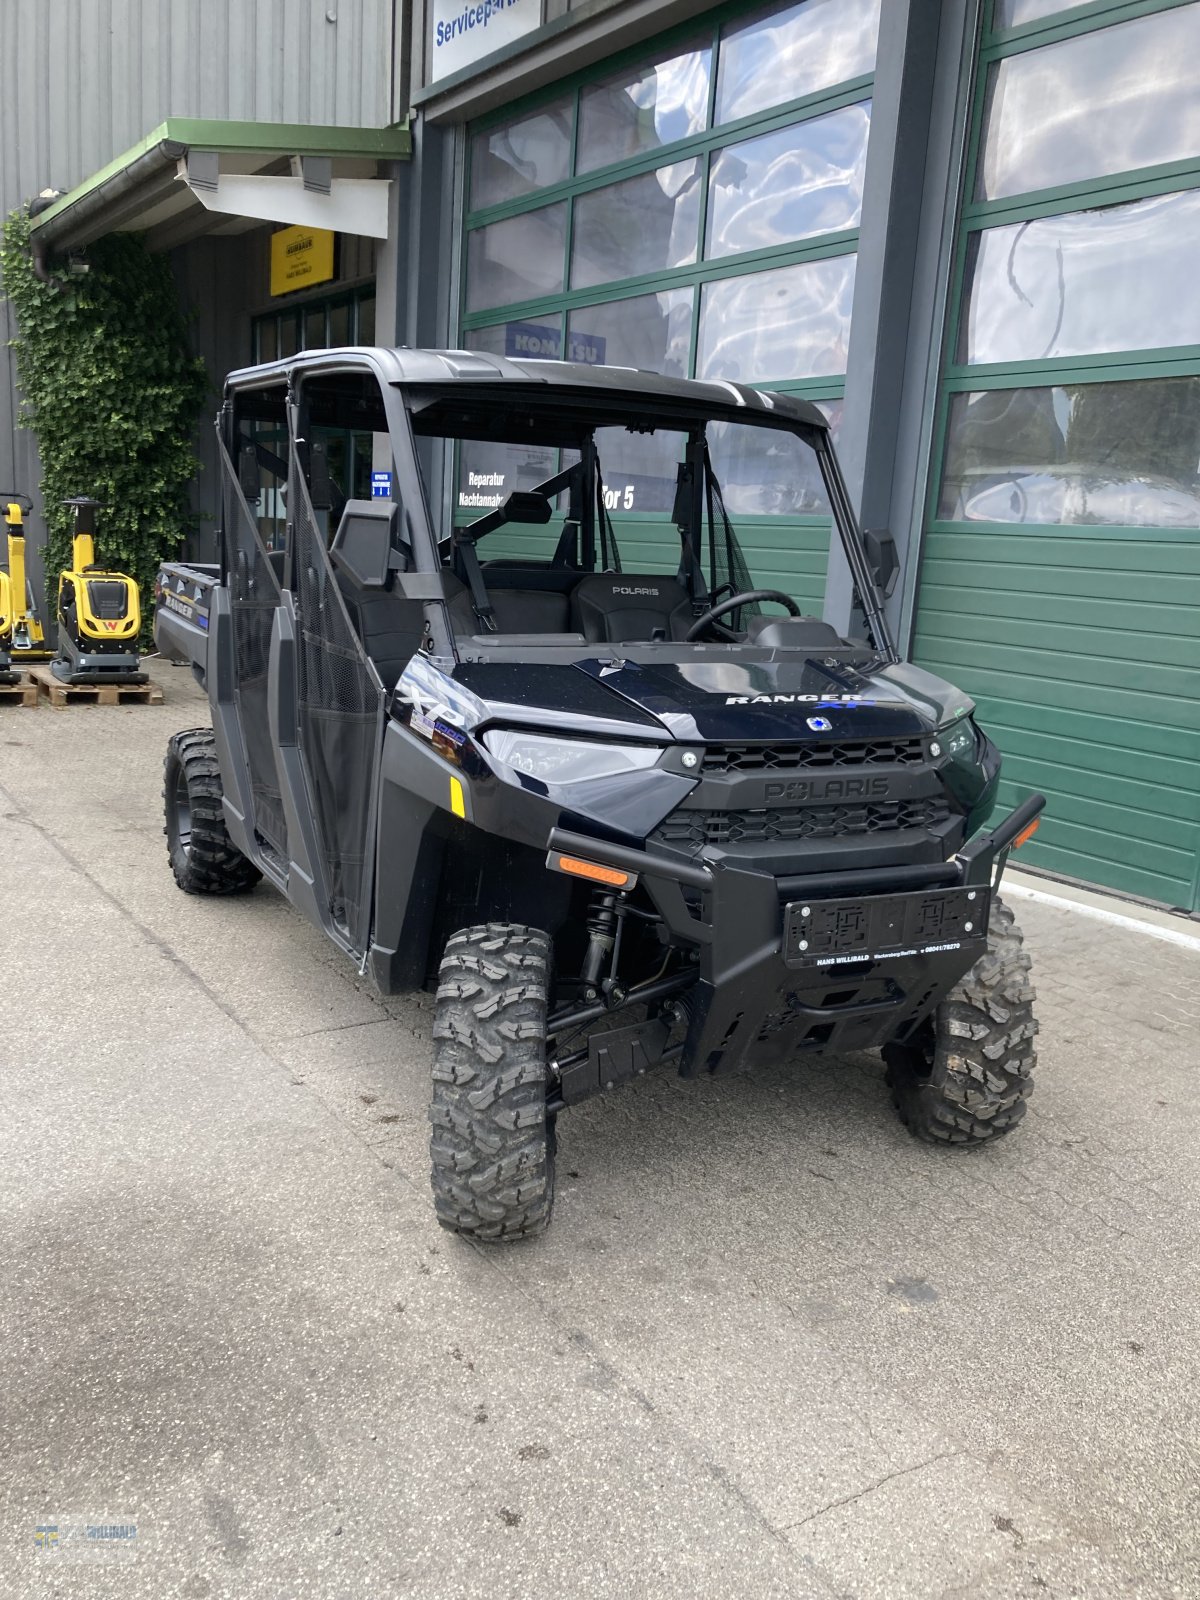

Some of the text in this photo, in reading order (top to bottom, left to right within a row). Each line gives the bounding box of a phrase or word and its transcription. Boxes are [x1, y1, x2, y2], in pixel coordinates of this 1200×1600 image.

[468, 471, 505, 488] Reparatur
[459, 492, 504, 507] Nachtannah
[623, 485, 635, 510] 5
[612, 586, 660, 596] POLARIS
[165, 596, 193, 619] RANGER
[725, 694, 863, 705] RANGER
[764, 777, 890, 803] POLARIS
[817, 958, 835, 966] HANS
[836, 954, 870, 964] WILLIBALD
